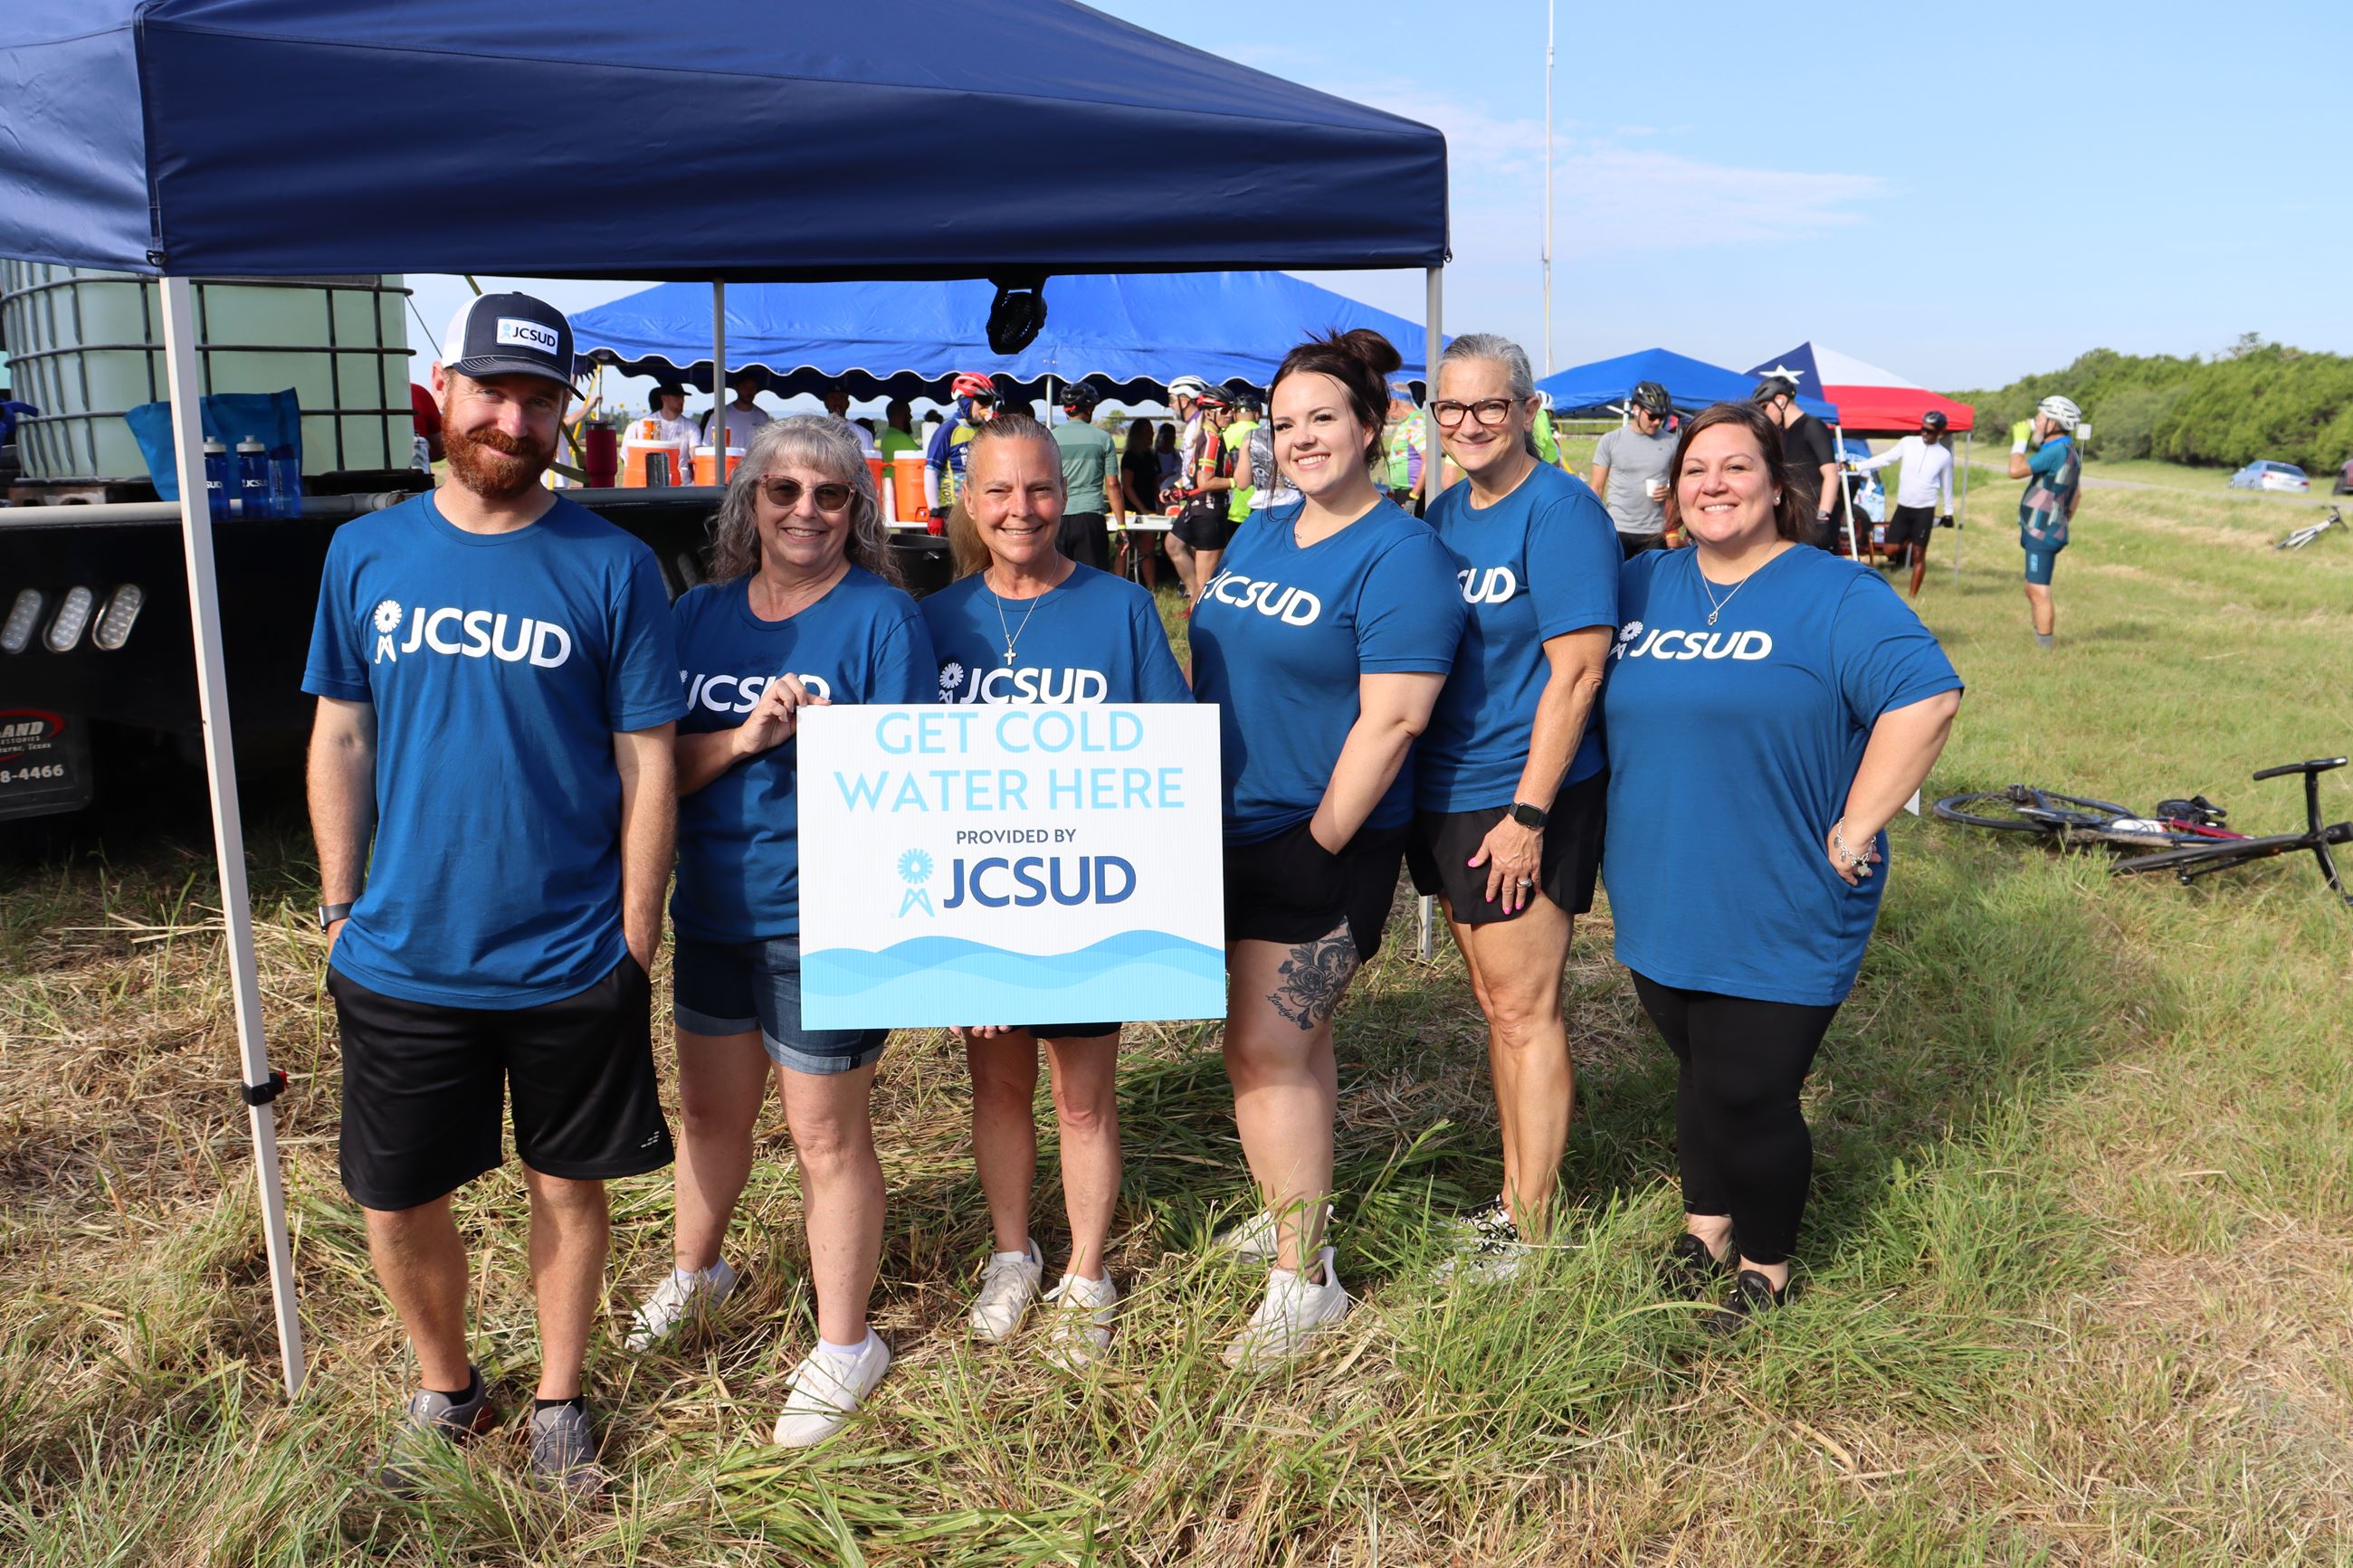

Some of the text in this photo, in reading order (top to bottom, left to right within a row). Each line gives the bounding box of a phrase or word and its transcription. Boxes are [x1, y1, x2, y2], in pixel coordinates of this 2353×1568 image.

[513, 327, 556, 347] JCSUD
[1204, 571, 1321, 626] JCSUD
[401, 607, 572, 669] JCSUD
[1629, 630, 1773, 660] JCSUD
[960, 667, 1108, 704] JCSUD
[0, 721, 44, 737] AND
[875, 710, 1144, 755] GET COLD
[833, 767, 1186, 813] WATER HERE
[956, 828, 1077, 844] PROVIDED BY
[943, 855, 1137, 909] JCSUD
